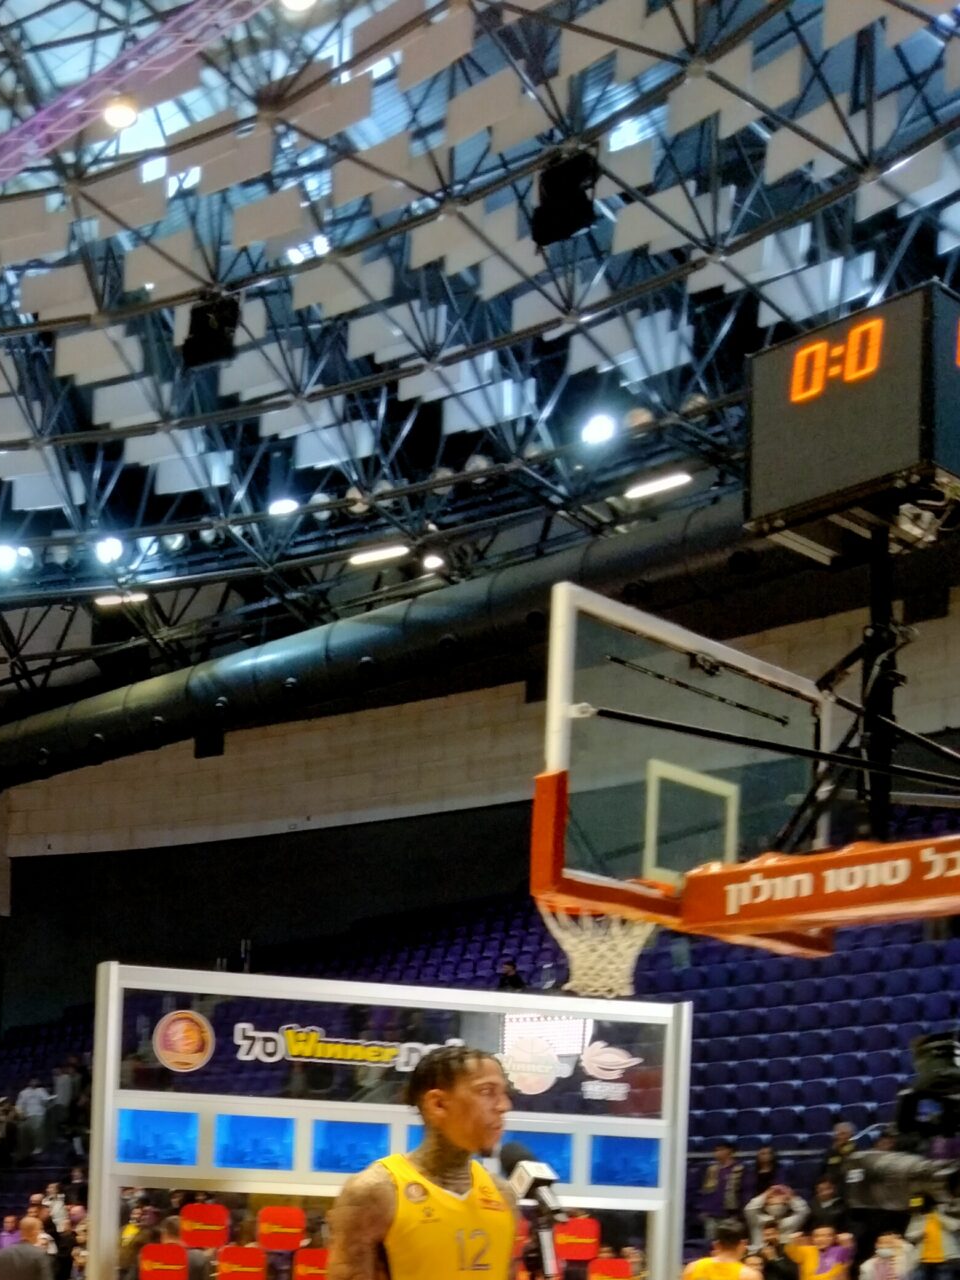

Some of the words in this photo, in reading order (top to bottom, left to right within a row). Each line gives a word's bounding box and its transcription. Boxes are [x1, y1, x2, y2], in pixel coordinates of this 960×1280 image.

[724, 872, 815, 916] חולון
[284, 1027, 399, 1063] Winner
[455, 1228, 492, 1271] 12
